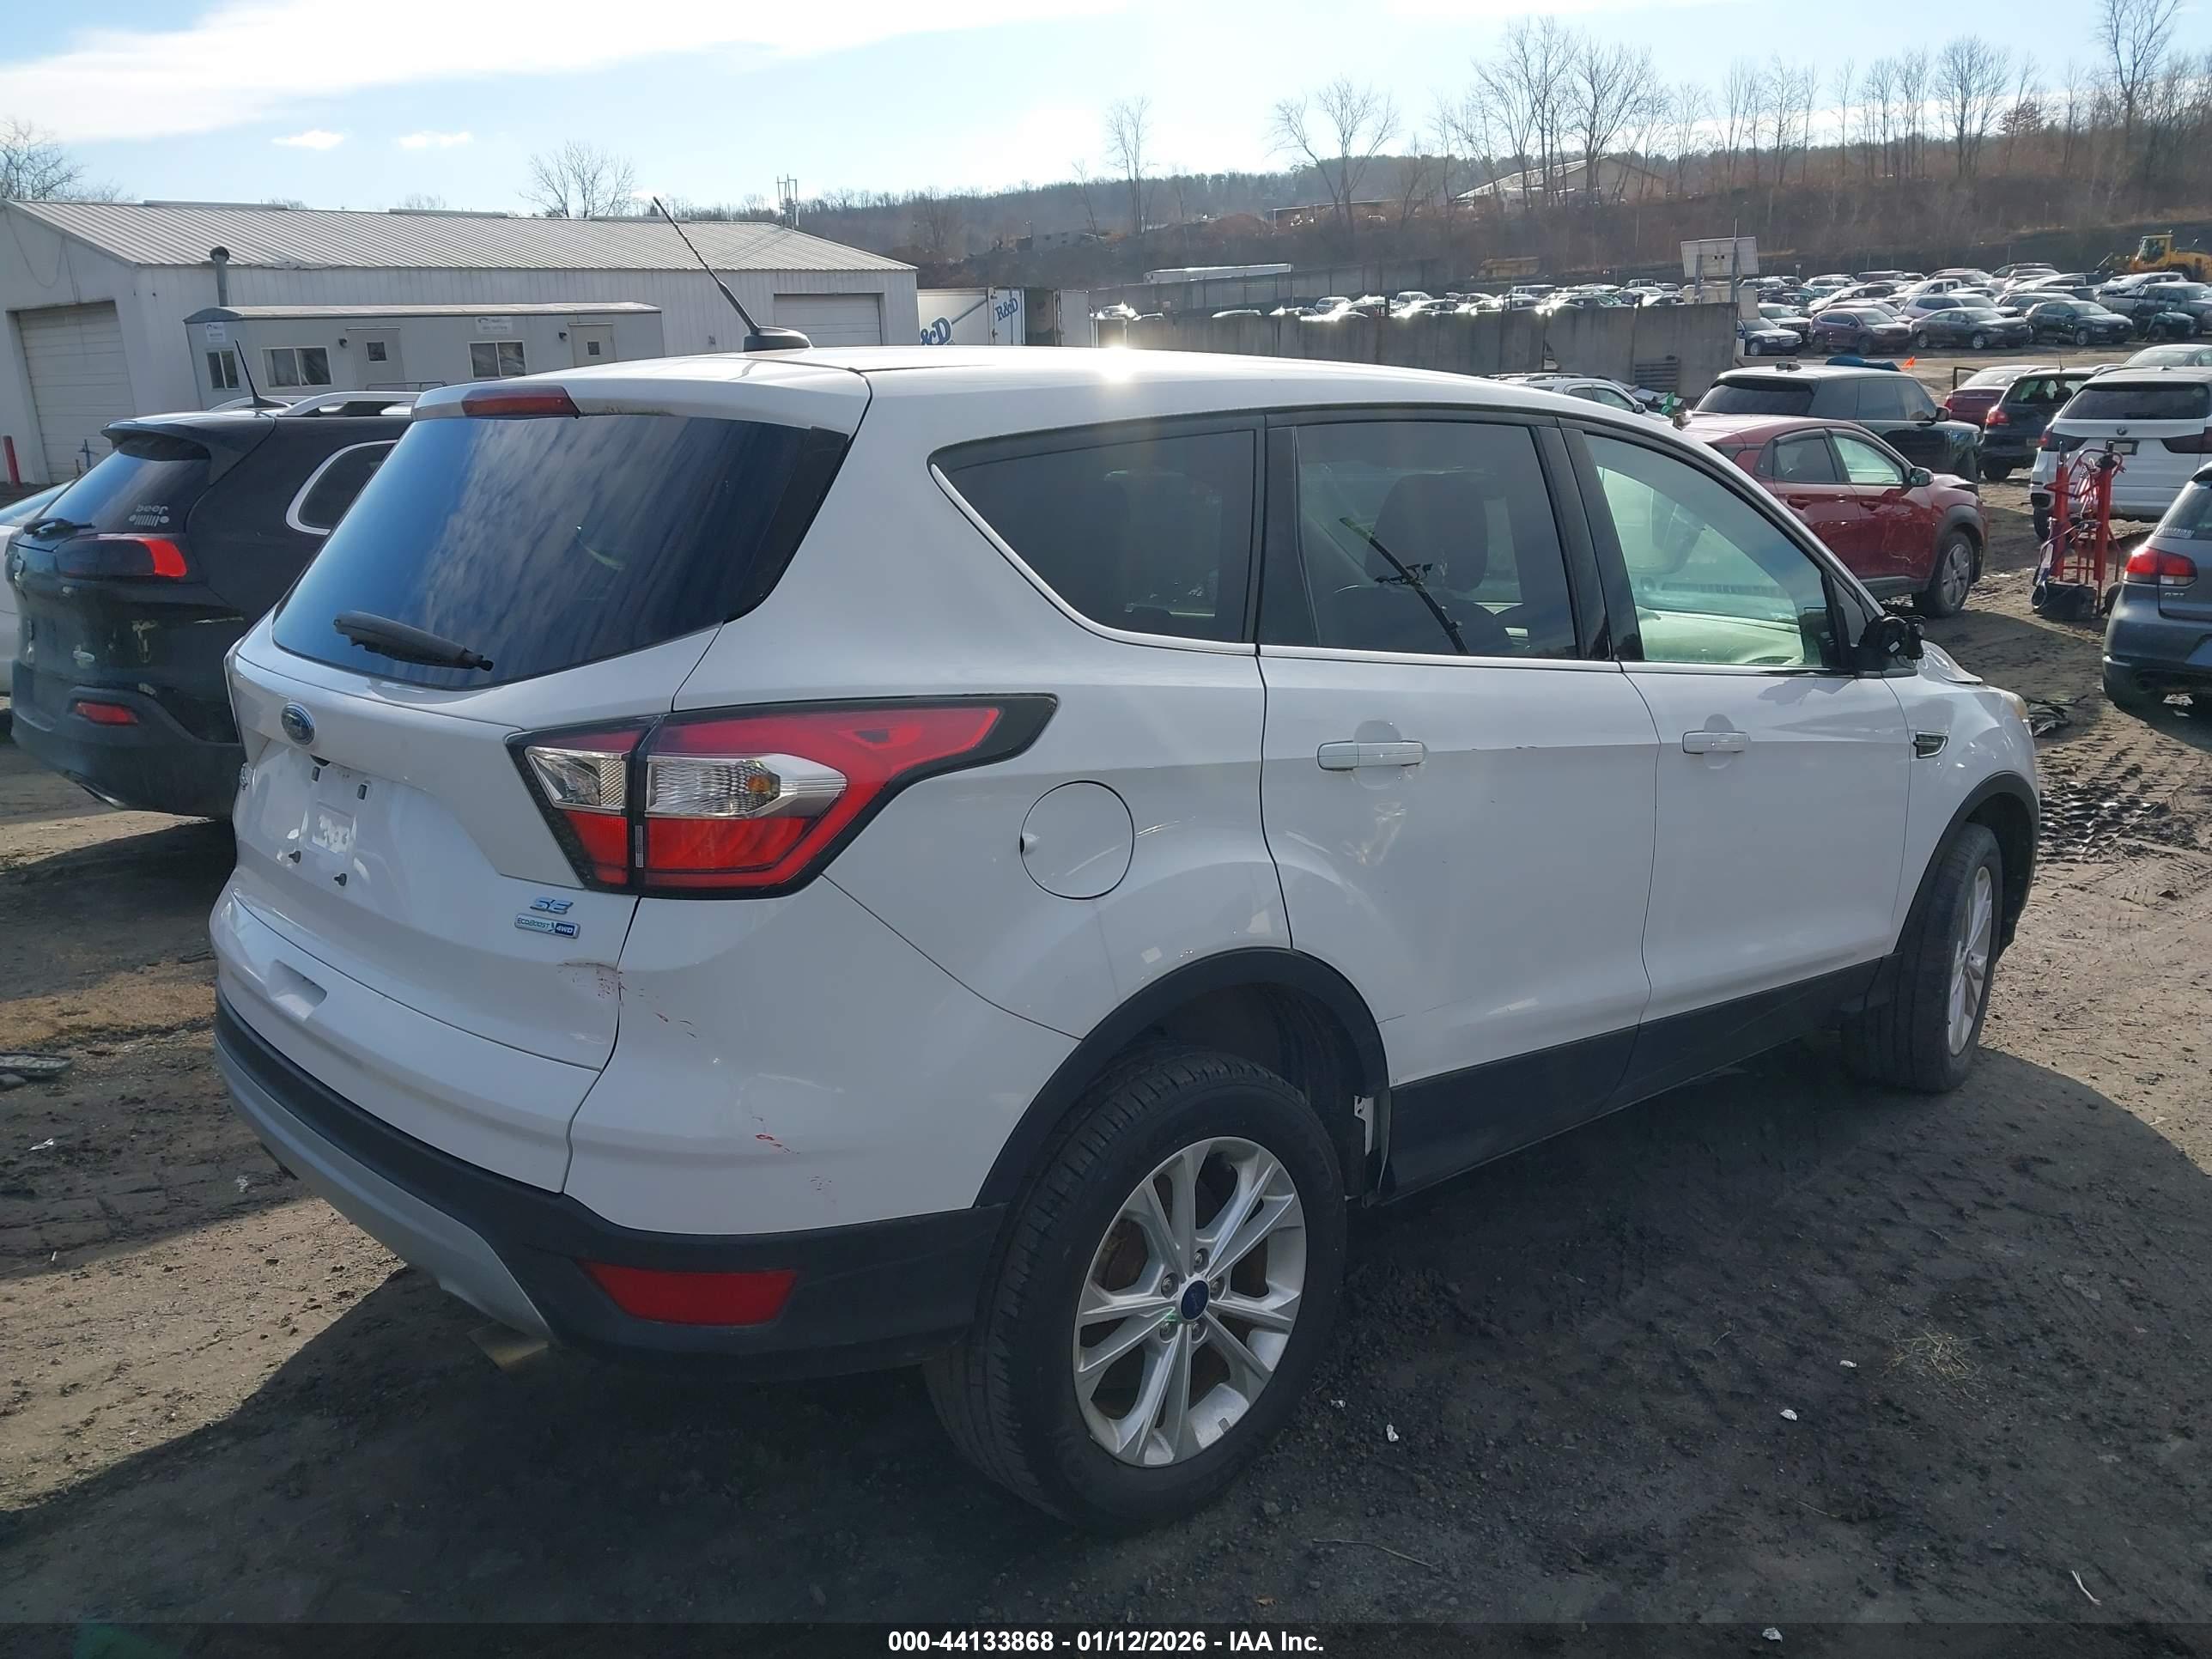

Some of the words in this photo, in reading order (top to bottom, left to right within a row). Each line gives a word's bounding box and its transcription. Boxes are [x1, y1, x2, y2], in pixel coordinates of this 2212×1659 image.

[995, 297, 1018, 321] R&D
[530, 896, 574, 915] SE
[556, 924, 574, 934] 4WD
